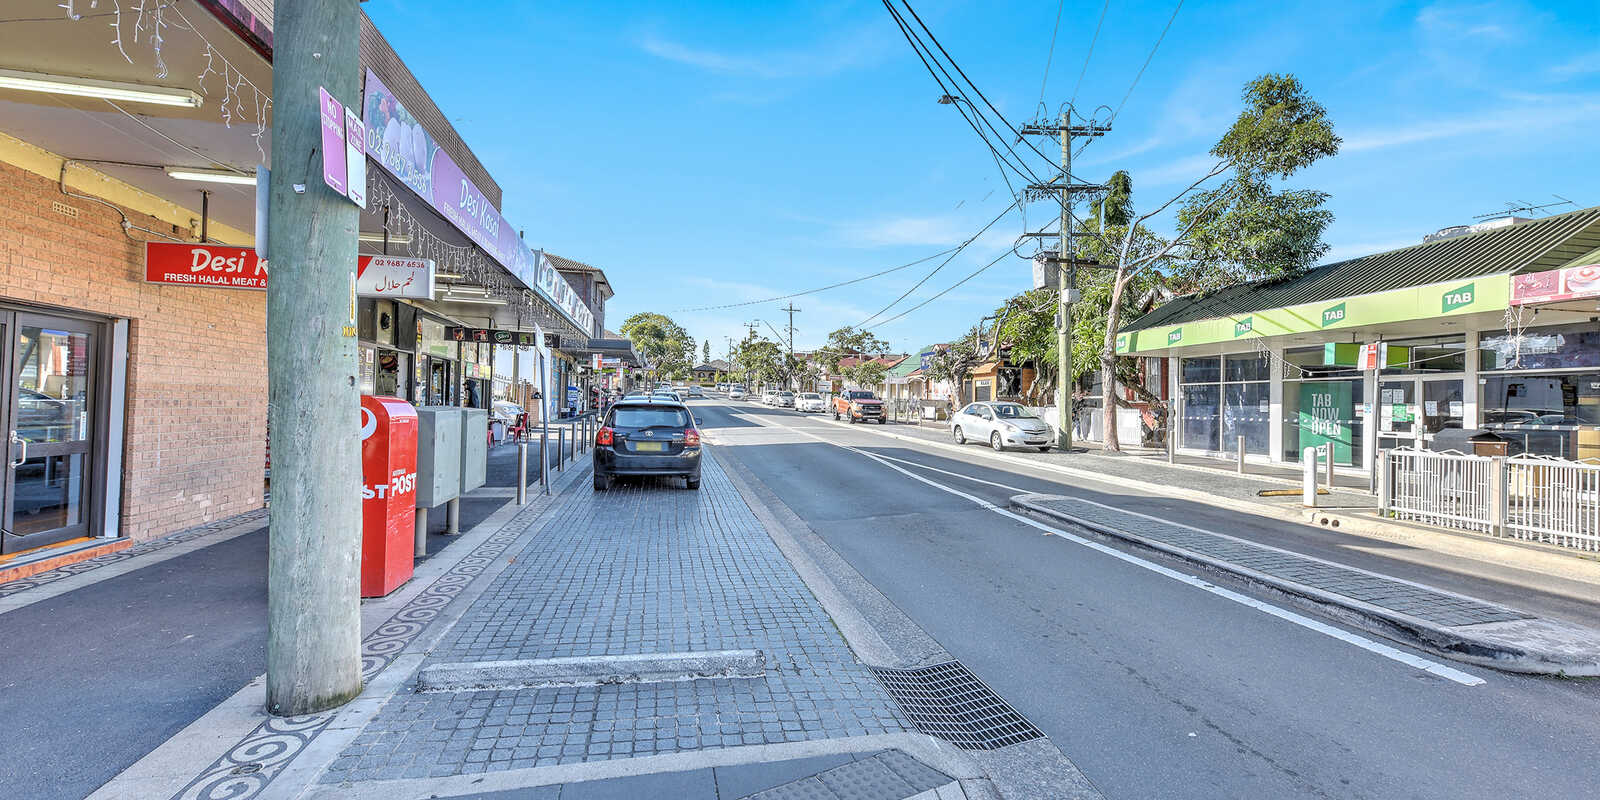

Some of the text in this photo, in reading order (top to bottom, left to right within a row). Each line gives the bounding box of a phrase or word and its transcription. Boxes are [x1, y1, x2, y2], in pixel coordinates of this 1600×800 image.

[327, 101, 337, 118] NO
[369, 128, 381, 154] 02
[460, 179, 480, 218] Desi
[190, 248, 247, 273] Desi
[164, 273, 267, 287] FRESH HALAL MEAT &
[1445, 292, 1472, 305] TAB
[1324, 310, 1344, 321] TAB
[1236, 323, 1251, 332] TAB
[1169, 332, 1181, 341] TAB
[1311, 393, 1331, 407] TAB
[1311, 407, 1339, 421] NOW
[1311, 420, 1341, 435] OPEN
[361, 484, 389, 499] ST
[391, 472, 417, 497] POST
